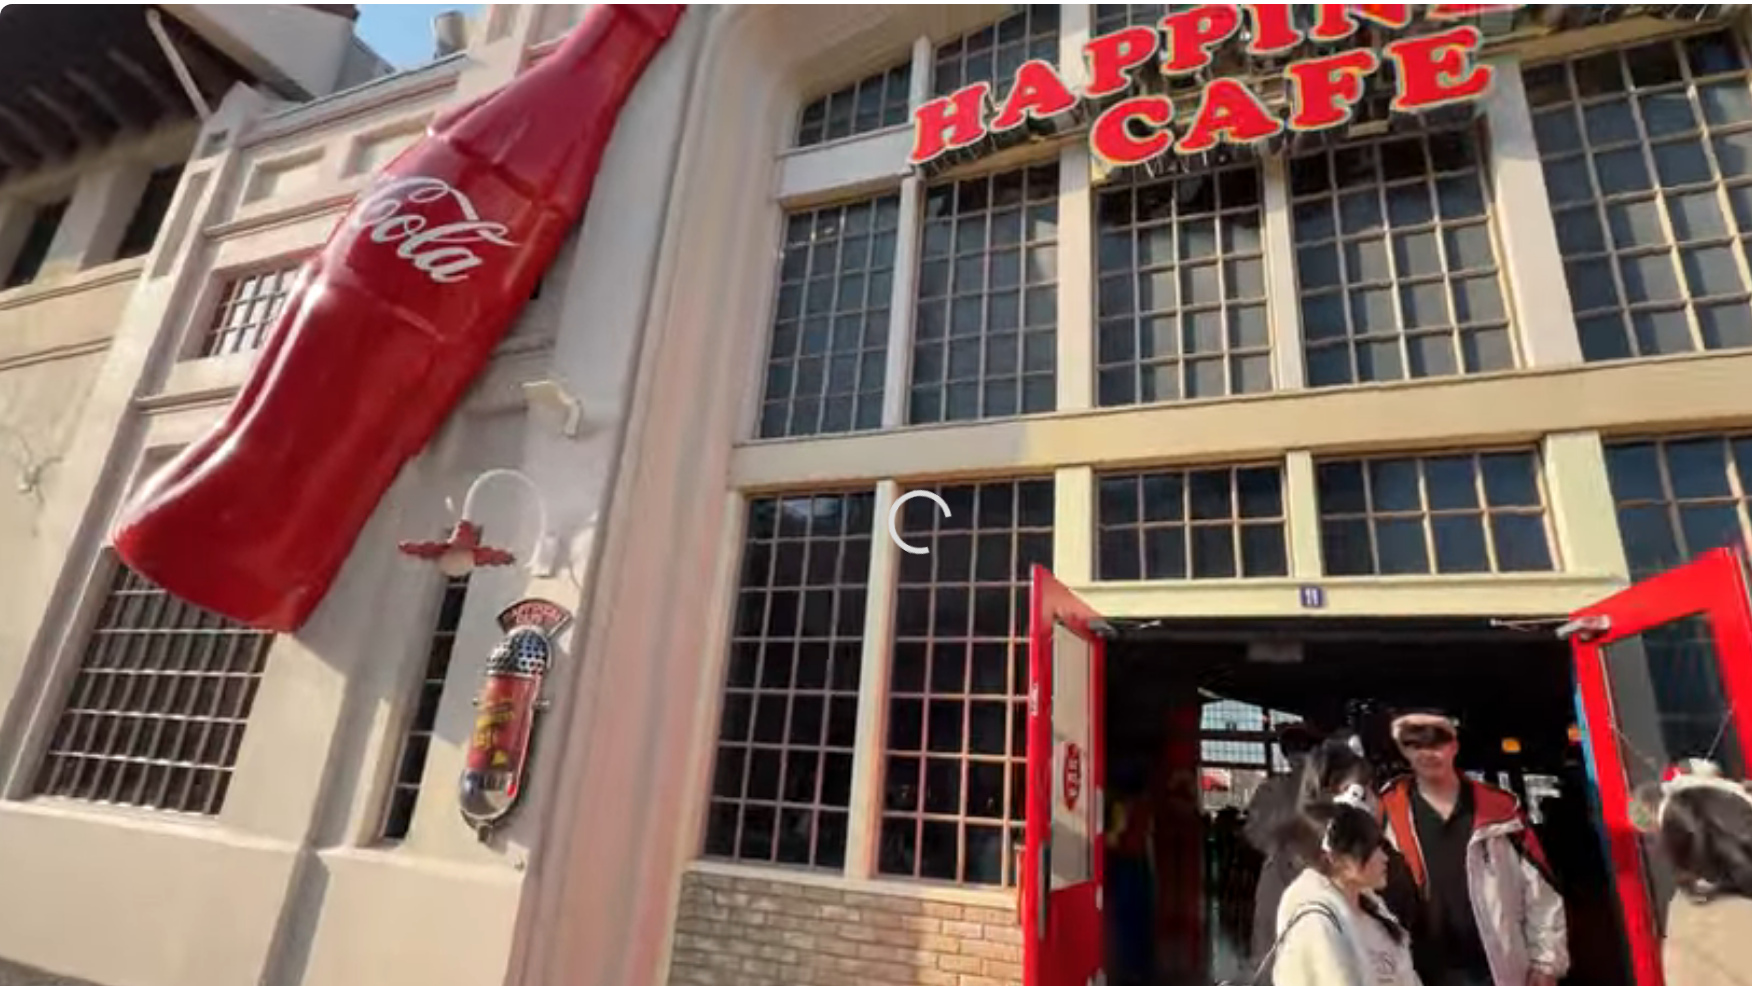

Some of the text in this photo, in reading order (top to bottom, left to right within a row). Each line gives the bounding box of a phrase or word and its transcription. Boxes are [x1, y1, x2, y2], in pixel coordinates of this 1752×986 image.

[912, 3, 1518, 163] HAPPI
[1092, 25, 1492, 166] CAFE
[354, 176, 519, 284] Cola
